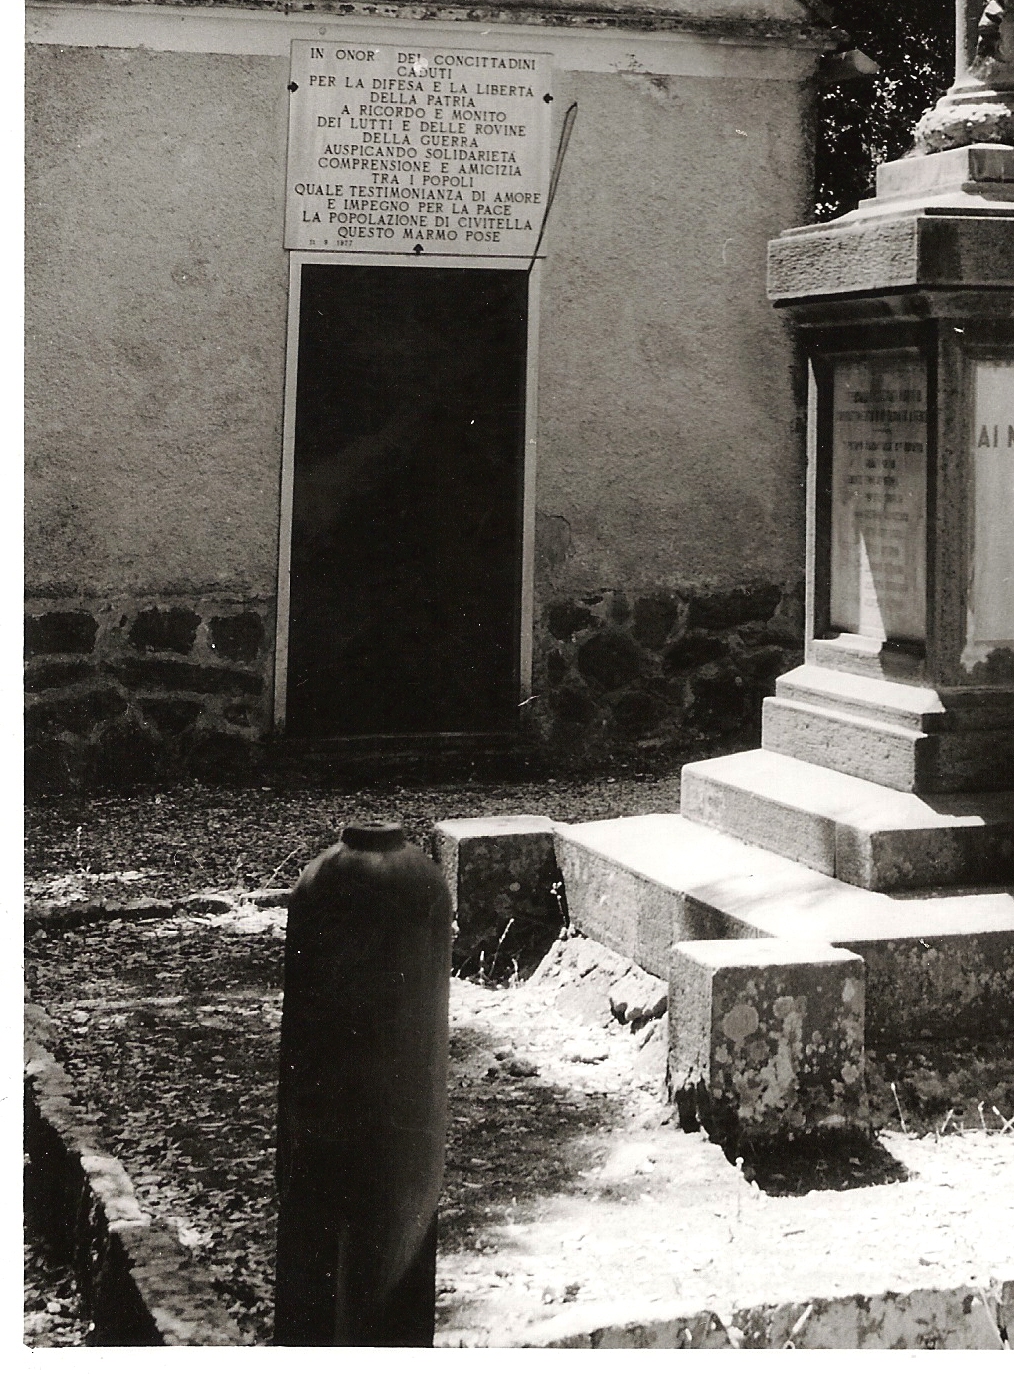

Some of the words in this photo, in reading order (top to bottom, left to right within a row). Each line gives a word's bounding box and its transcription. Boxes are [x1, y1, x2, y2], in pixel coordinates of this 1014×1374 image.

[310, 47, 324, 59] IN
[433, 54, 536, 71] CONCITTADINI
[397, 66, 452, 80] CADUTI
[310, 75, 336, 87] PER
[345, 77, 365, 89] LA
[372, 78, 423, 92] DIFESA
[434, 82, 441, 92] E
[450, 82, 468, 94] LA
[370, 92, 417, 105] DELLA
[427, 95, 476, 108] PATRIA
[341, 105, 350, 115] A
[360, 105, 426, 118] RICORDO
[435, 109, 443, 119] E
[452, 109, 507, 122] MONITO
[317, 116, 341, 128] DEI
[350, 118, 392, 130] LUTTI
[402, 120, 410, 131] E
[420, 121, 466, 134] DELLE
[475, 123, 527, 136] ROVINE
[363, 132, 411, 145] DELLA
[420, 135, 479, 148] GUERRA
[324, 145, 417, 158] AUSPICANDO
[318, 158, 431, 173] COMPRENSIONE
[441, 162, 449, 173] E
[459, 164, 522, 177] AMICIZIA
[371, 173, 400, 185] TRA
[410, 175, 414, 185] I
[422, 177, 474, 188] POPOLI
[294, 183, 343, 197] QUALE
[349, 186, 463, 202] TESTIMONIANZA
[472, 191, 485, 202] DI
[494, 192, 541, 204] AMORE
[327, 199, 336, 210] E
[344, 199, 410, 212] IMPEGNO
[418, 202, 444, 213] PER
[452, 204, 469, 215] LA
[477, 205, 512, 216] PACE
[302, 211, 321, 223] LA
[329, 212, 428, 227] POPOLAZIONE
[435, 216, 450, 227] DI
[458, 217, 533, 231] CIVITELLA
[338, 227, 395, 240] QUESTO
[402, 228, 458, 240] MARMO
[466, 231, 501, 243] POSE
[977, 425, 997, 447] AI
